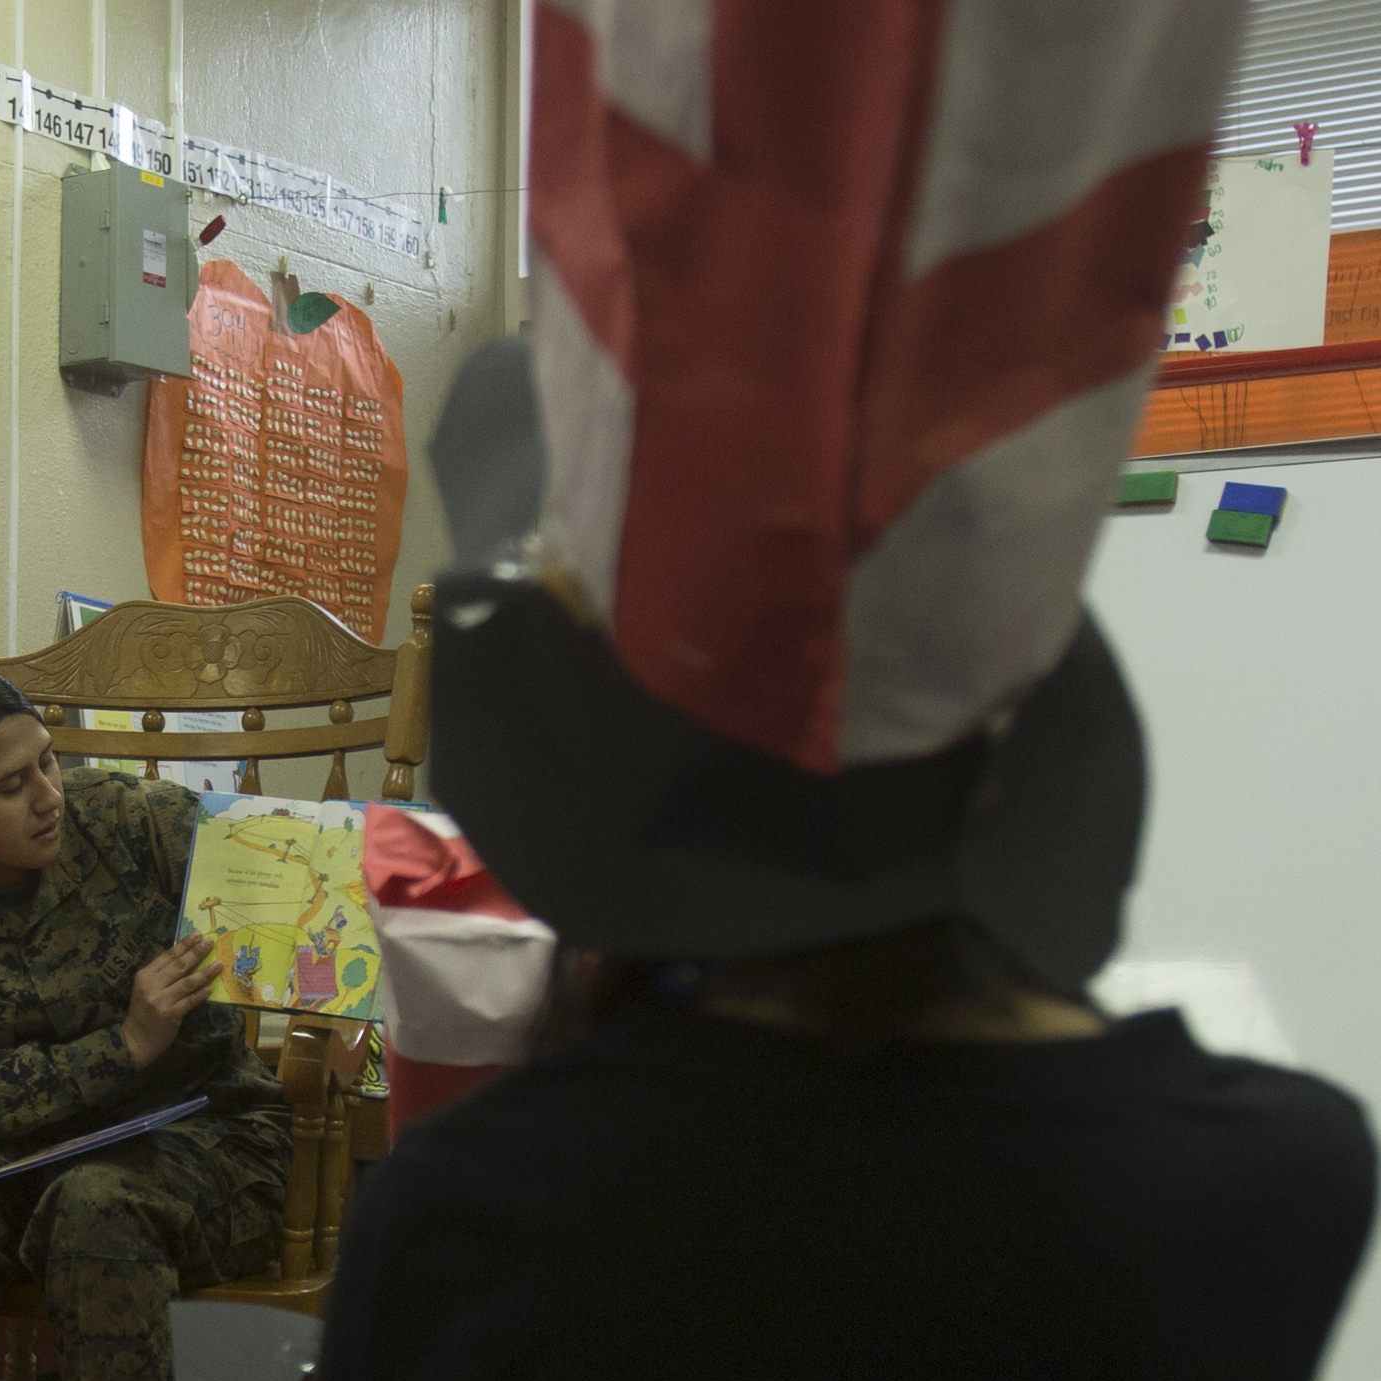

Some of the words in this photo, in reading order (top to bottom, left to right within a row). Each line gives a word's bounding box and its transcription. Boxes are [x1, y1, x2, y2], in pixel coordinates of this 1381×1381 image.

[8, 97, 26, 120] 14
[35, 108, 62, 138] 146
[65, 118, 94, 146] 147
[147, 149, 172, 176] 150
[183, 161, 205, 185] 151
[304, 196, 326, 219] 156
[333, 206, 354, 230] 157
[356, 214, 376, 239] 158
[378, 223, 398, 247] 159
[400, 232, 420, 257] 160
[206, 303, 248, 350] 394
[102, 954, 129, 980] U.S.
